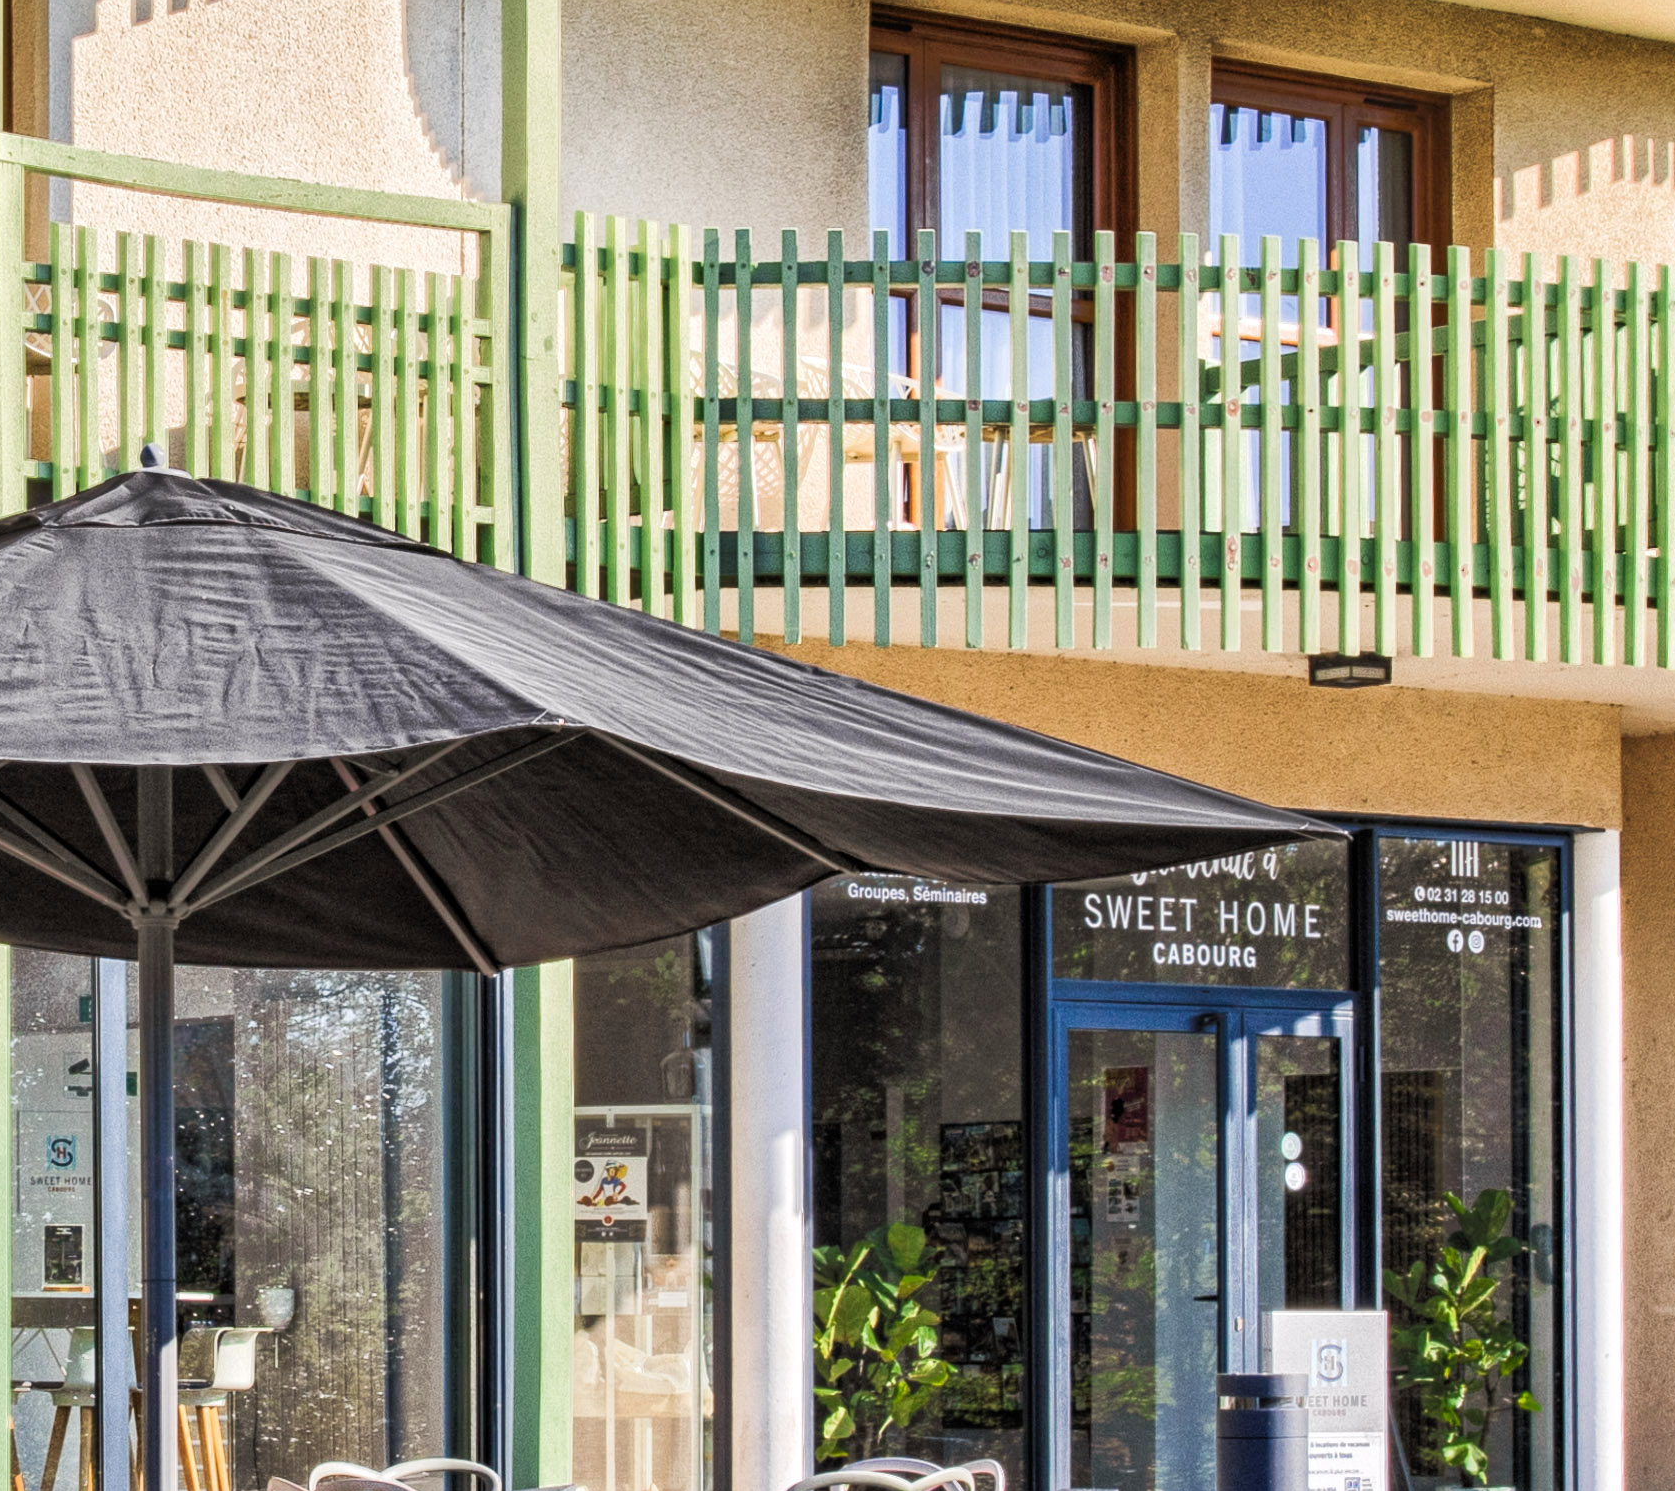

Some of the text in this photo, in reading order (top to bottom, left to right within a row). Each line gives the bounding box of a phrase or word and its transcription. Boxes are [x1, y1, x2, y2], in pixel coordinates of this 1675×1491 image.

[848, 883, 987, 904] Groupes, Séminaires
[1427, 887, 1509, 905] 02 31 28 15 00
[1084, 893, 1322, 938] SWEET HOME
[1386, 908, 1542, 929] sweethome-cabourg.com
[1153, 942, 1257, 968] CABOURG
[579, 1132, 638, 1150] Jeannette
[64, 1176, 92, 1186] HOME
[1308, 1395, 1368, 1407] EET HOME
